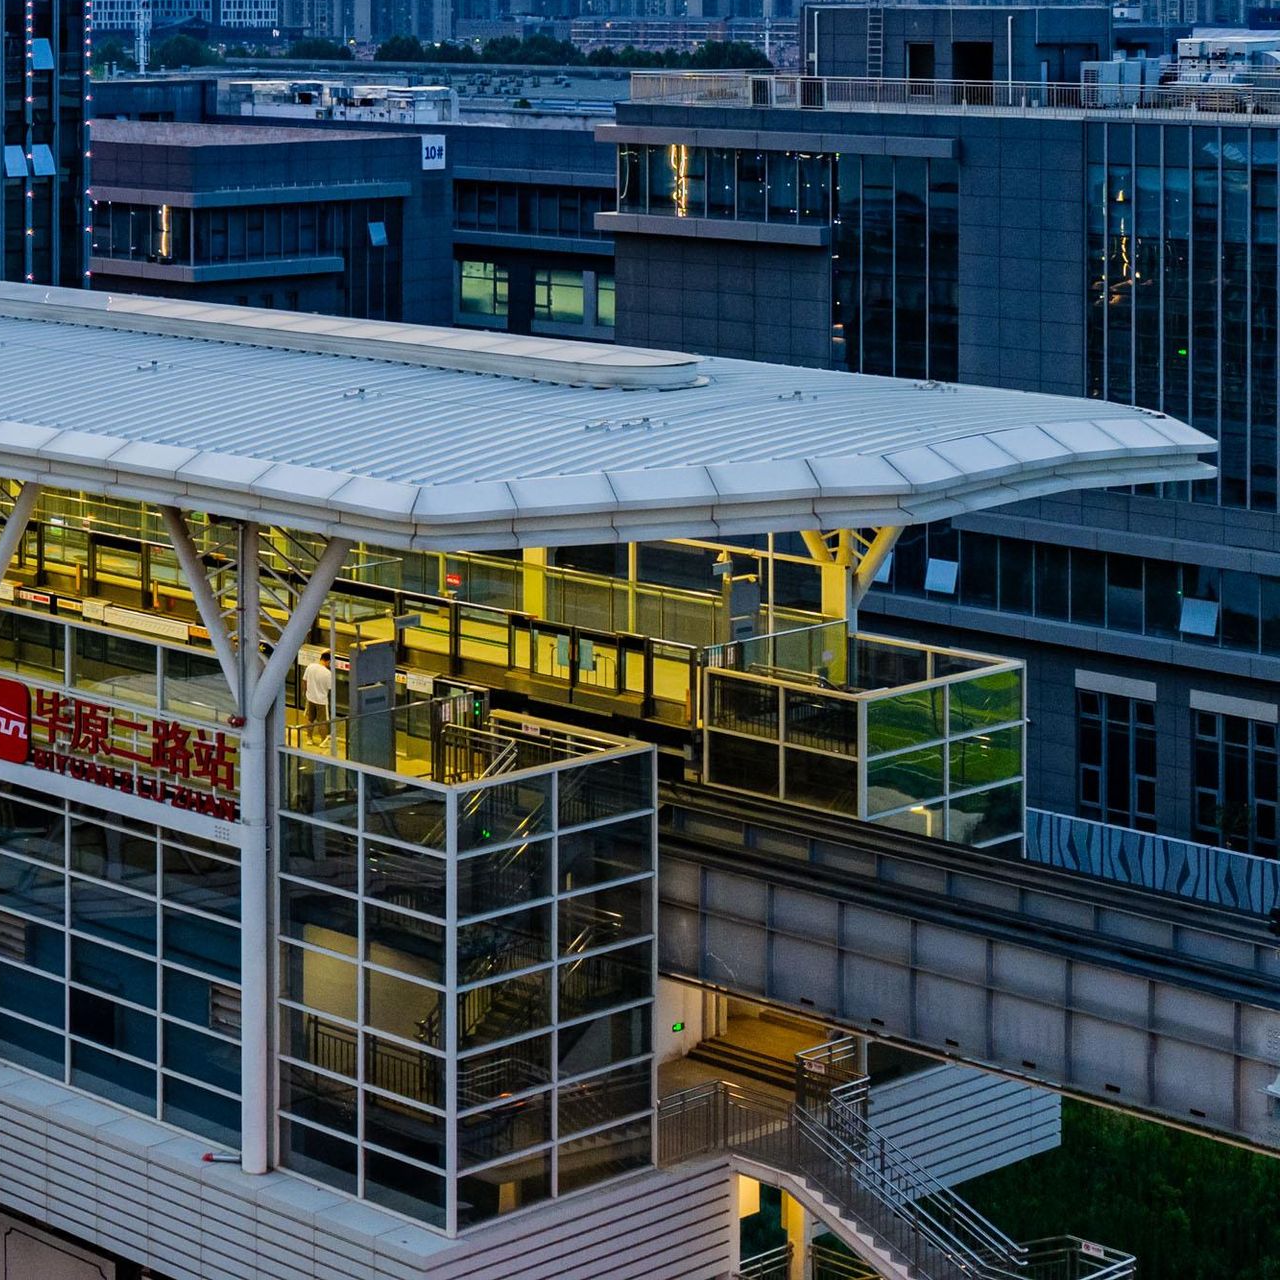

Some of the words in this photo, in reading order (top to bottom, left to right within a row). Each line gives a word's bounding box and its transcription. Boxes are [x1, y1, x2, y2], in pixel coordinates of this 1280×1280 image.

[424, 146, 444, 160] 10#
[33, 688, 237, 790] 毕原二路站
[34, 748, 116, 790] BIYUAN
[120, 770, 134, 794] 2
[137, 776, 167, 804] LU
[171, 785, 236, 823] ZHAN
